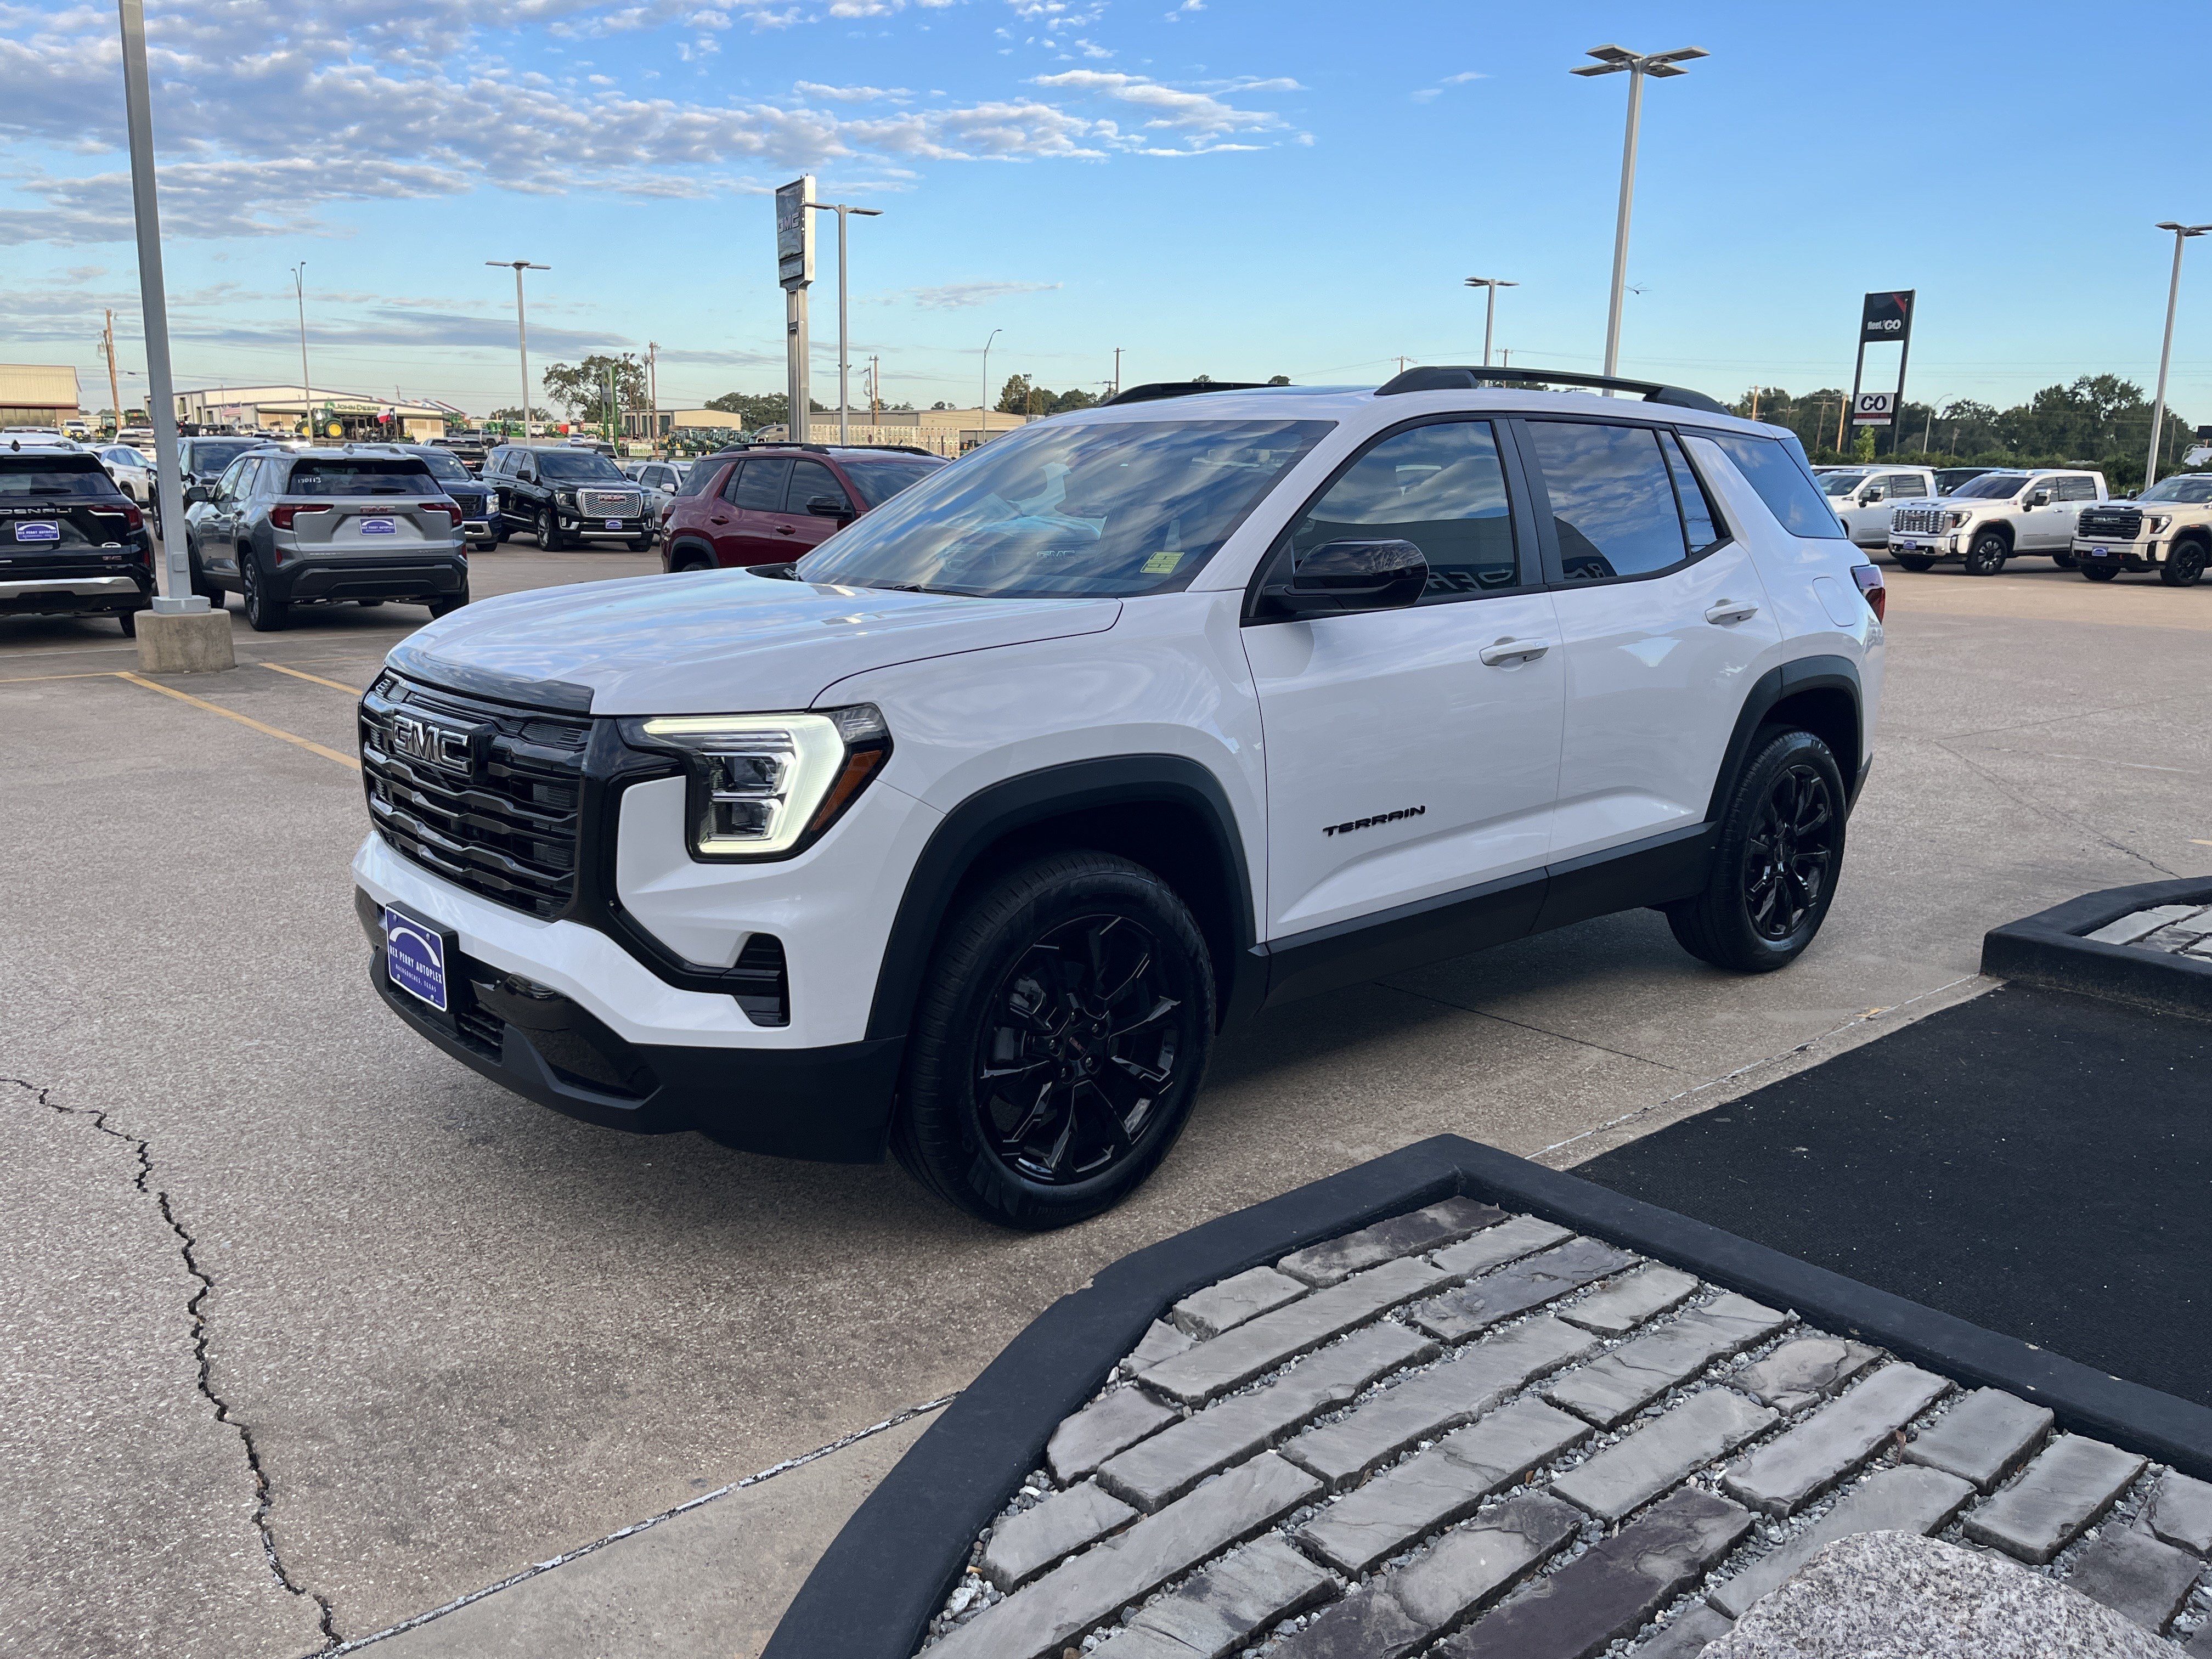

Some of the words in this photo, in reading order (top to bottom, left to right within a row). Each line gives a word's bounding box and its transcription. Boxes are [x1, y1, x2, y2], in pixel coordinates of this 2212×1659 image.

[778, 212, 800, 234] GMC
[1036, 550, 1075, 561] GMC
[392, 715, 468, 772] GMC
[1323, 805, 1425, 836] TERRAIN
[390, 945, 398, 958] REX
[399, 951, 414, 968] PERRY
[416, 961, 442, 984] AUTOPLEX
[424, 980, 437, 993] TEXAS
